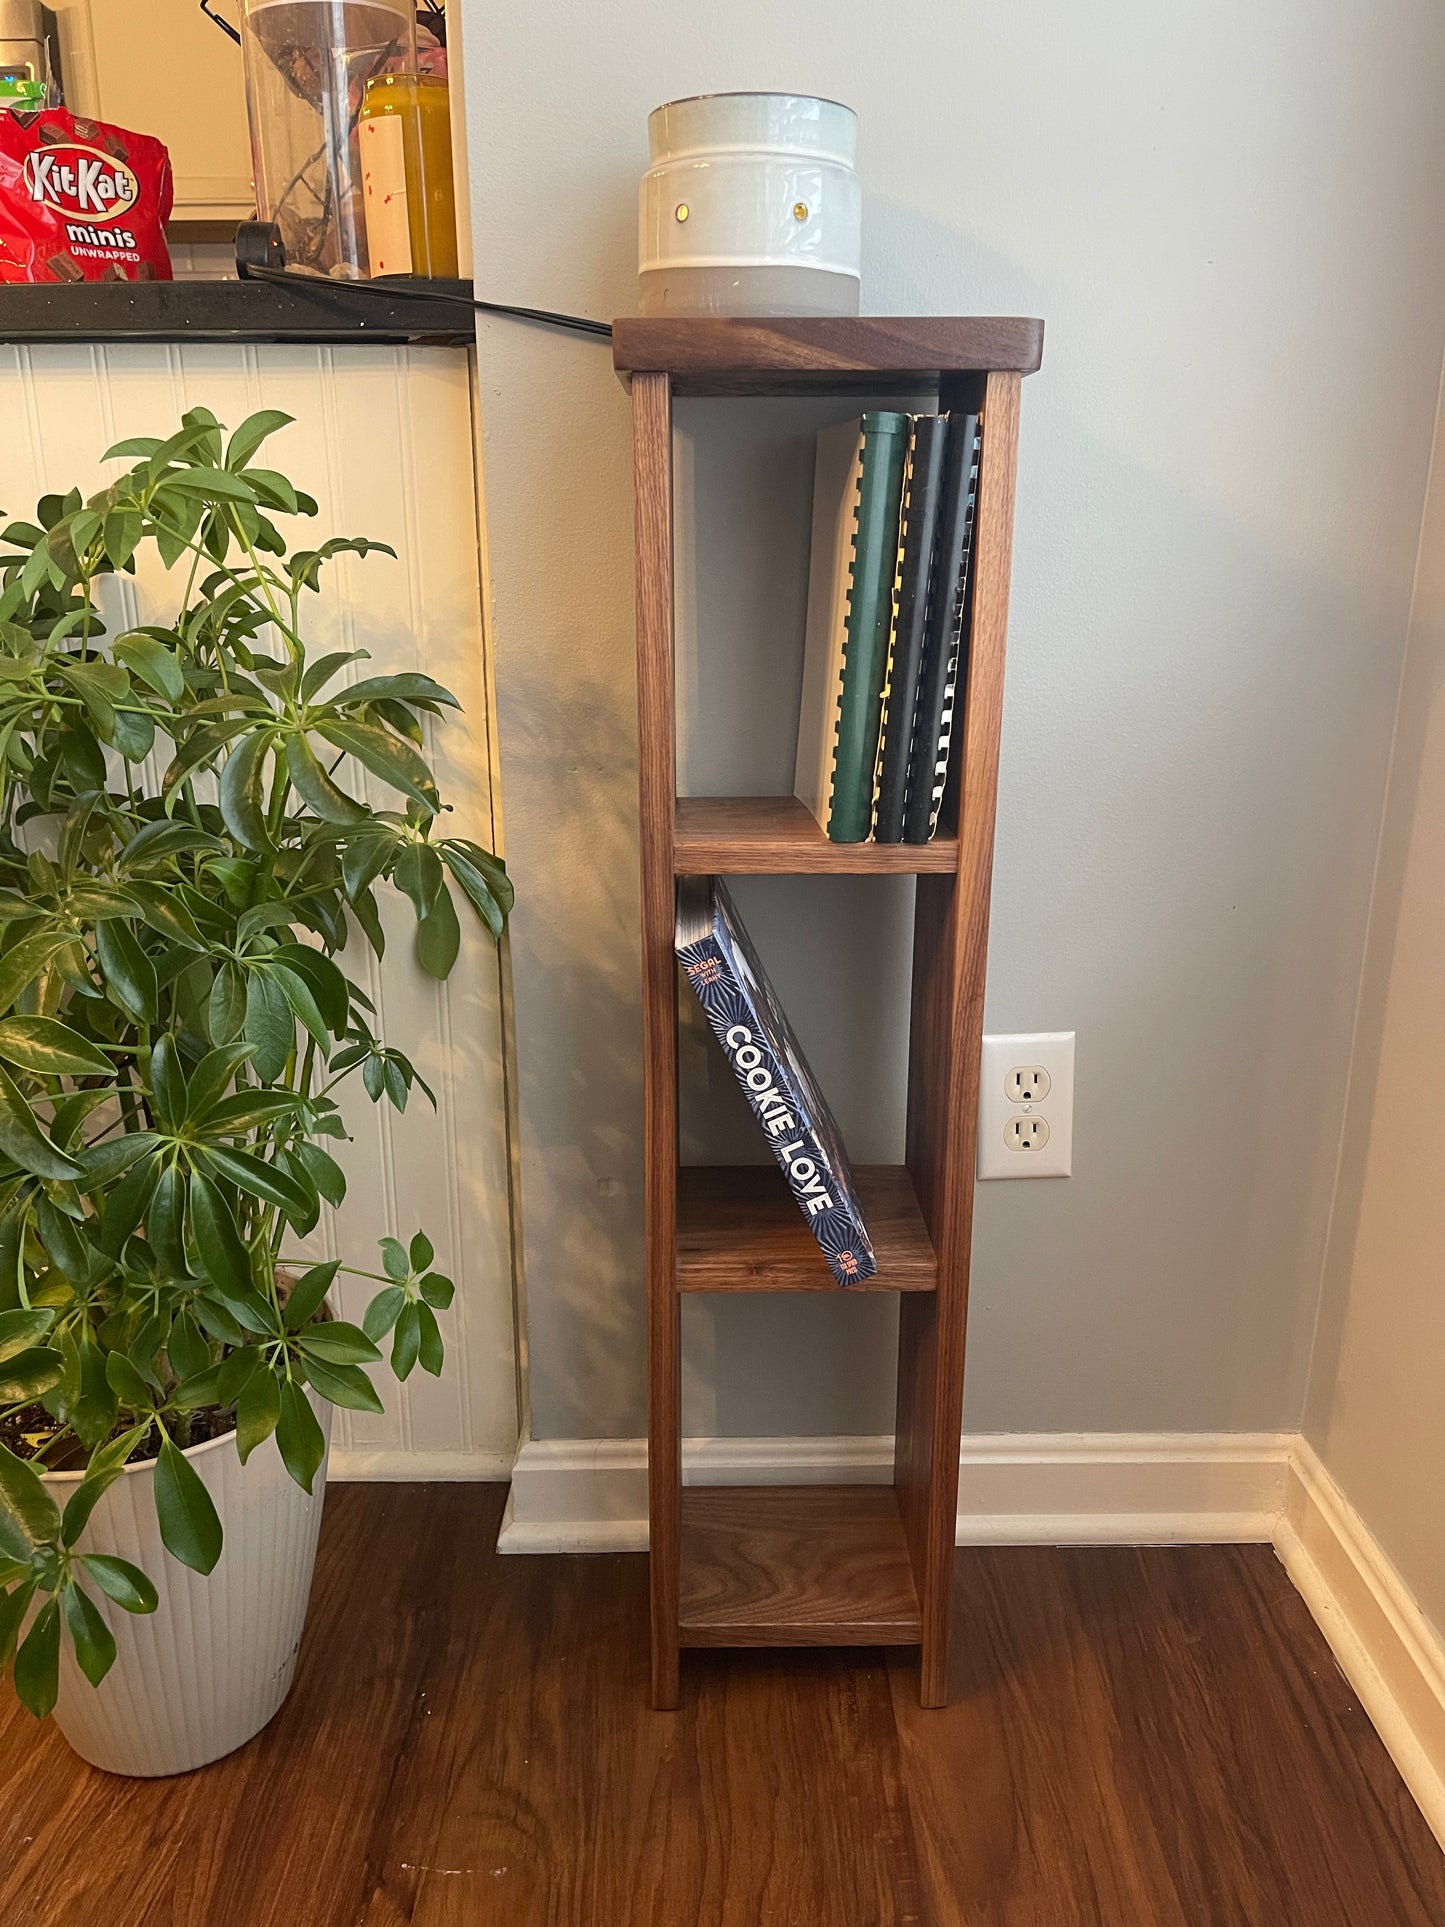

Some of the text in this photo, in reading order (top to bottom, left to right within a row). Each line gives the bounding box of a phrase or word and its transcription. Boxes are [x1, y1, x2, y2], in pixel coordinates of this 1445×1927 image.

[65, 224, 137, 248] minis
[70, 245, 141, 262] UNWRAPPED
[687, 956, 722, 976] SEGAL
[700, 967, 717, 978] WITH
[726, 1025, 833, 1217] COOKIE LOVE
